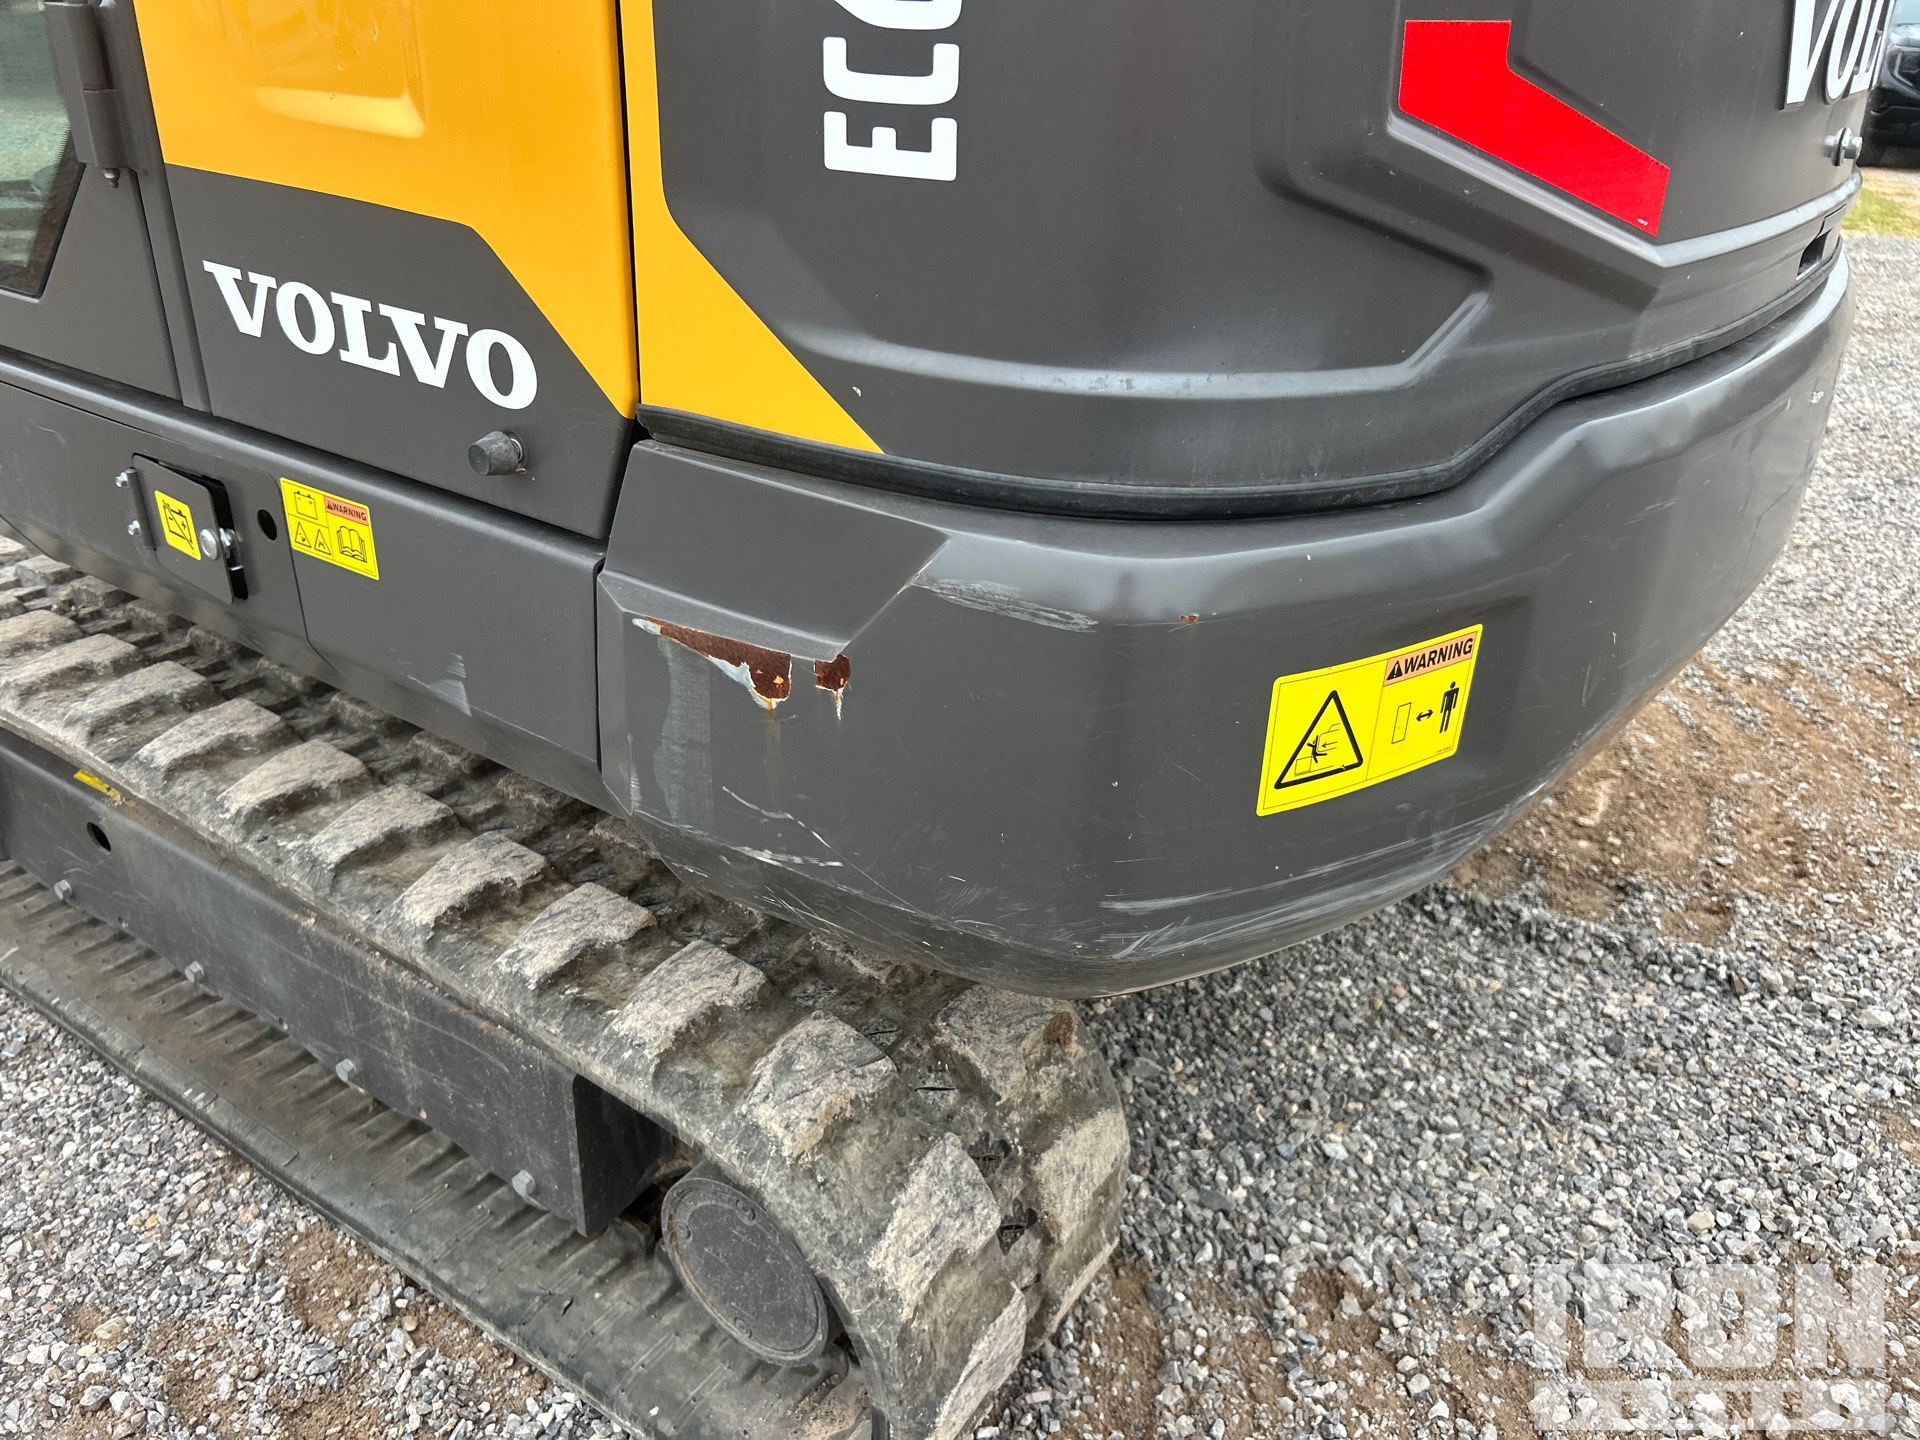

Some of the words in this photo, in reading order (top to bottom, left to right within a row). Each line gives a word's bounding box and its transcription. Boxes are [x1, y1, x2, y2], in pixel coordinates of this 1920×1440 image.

[203, 260, 538, 410] VOLVO
[333, 501, 367, 521] WARNING
[1404, 637, 1473, 674] WARNING
